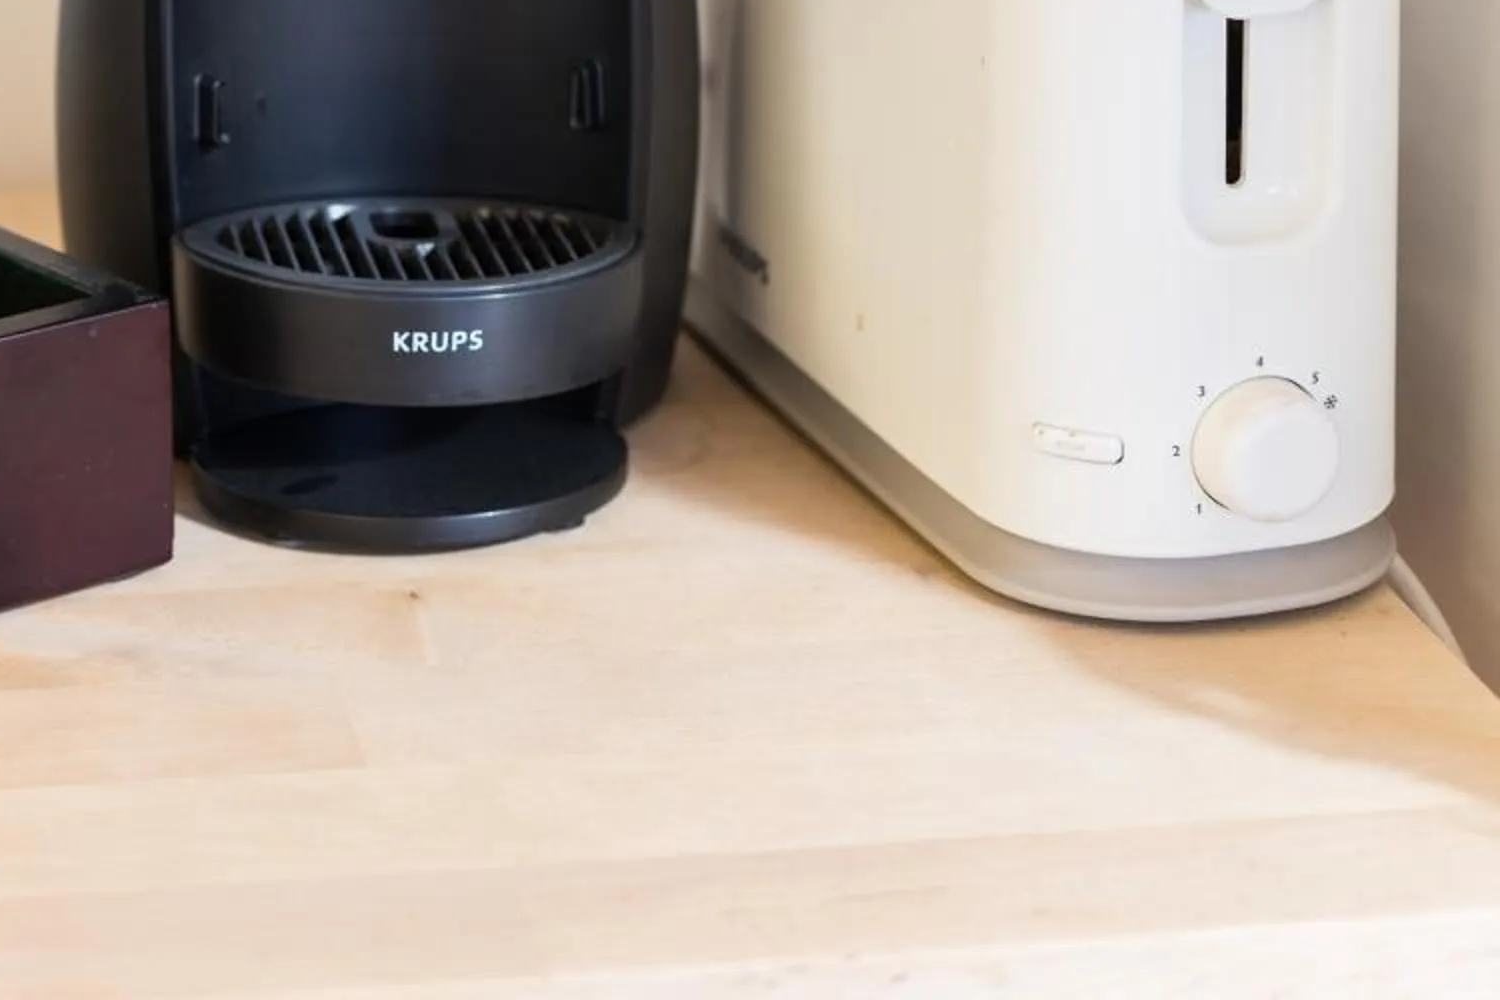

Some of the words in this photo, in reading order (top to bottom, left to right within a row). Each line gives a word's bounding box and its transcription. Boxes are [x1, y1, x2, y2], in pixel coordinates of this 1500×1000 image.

[393, 329, 484, 353] KRUPS
[1256, 355, 1264, 367] 4
[1312, 371, 1320, 384] 5
[1196, 385, 1205, 397] 3
[1172, 445, 1180, 456] 2
